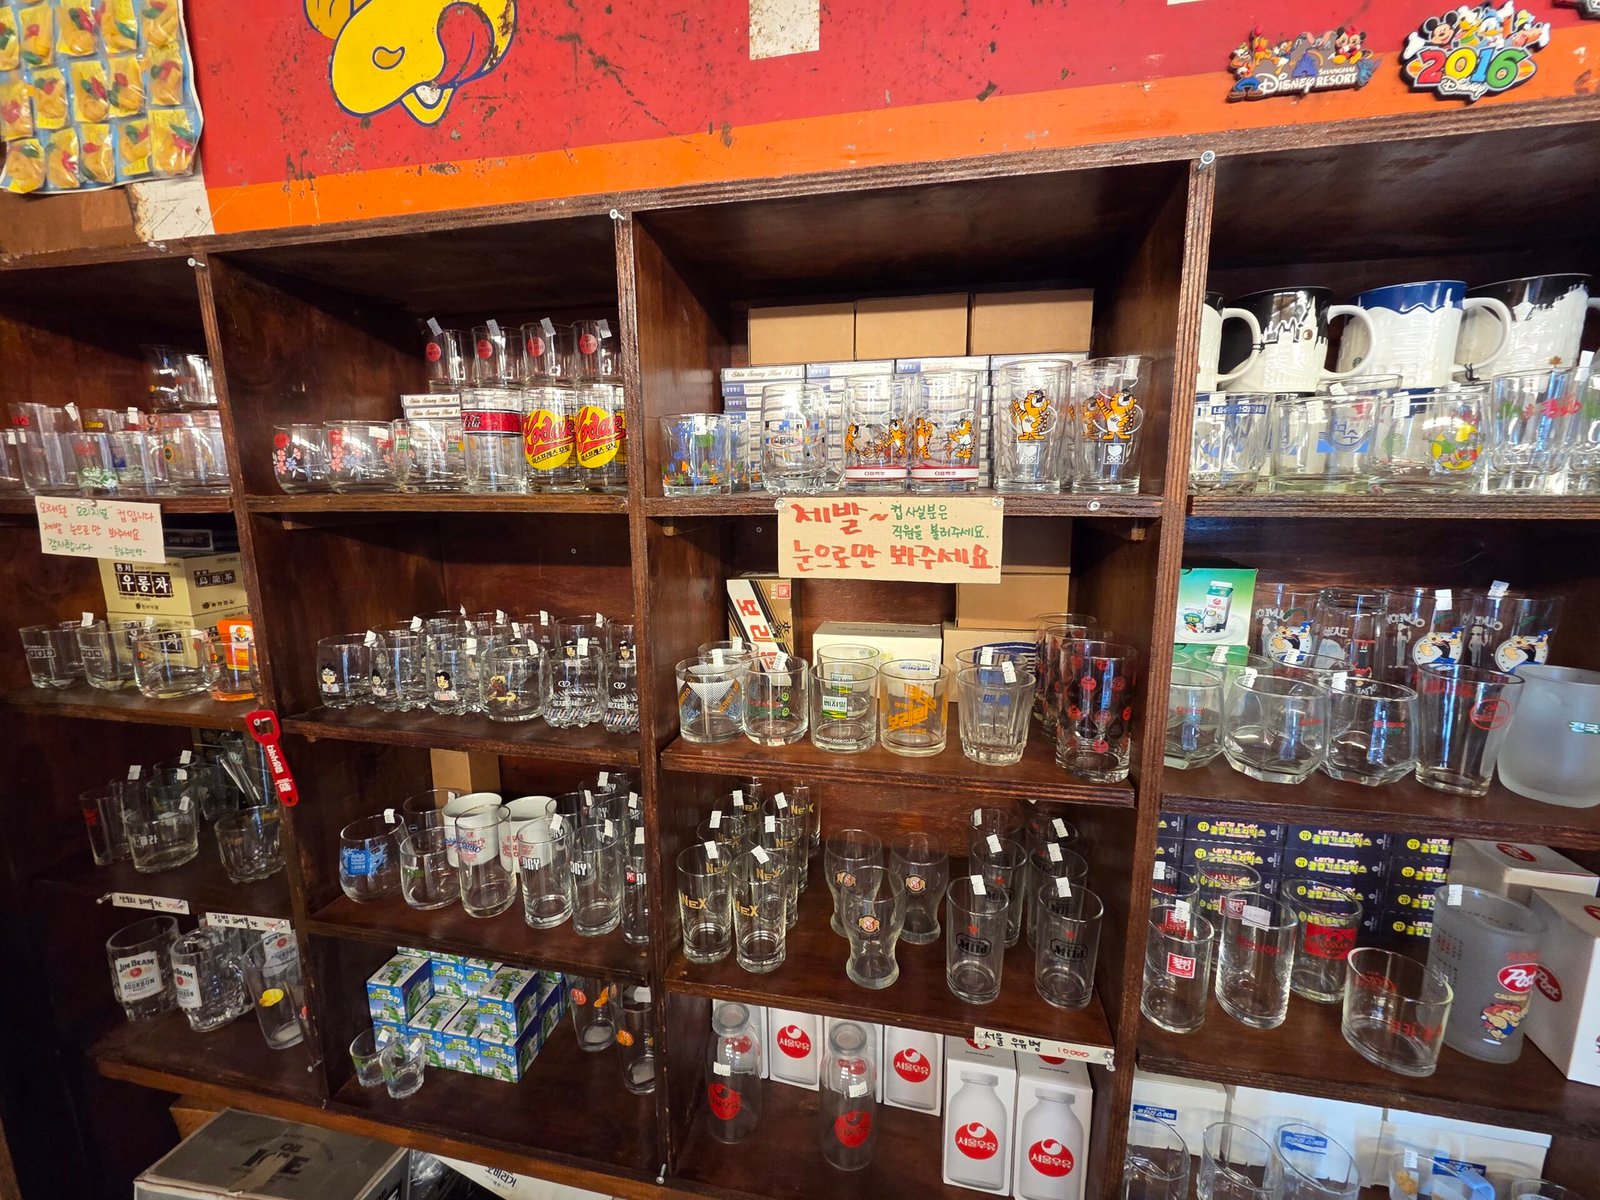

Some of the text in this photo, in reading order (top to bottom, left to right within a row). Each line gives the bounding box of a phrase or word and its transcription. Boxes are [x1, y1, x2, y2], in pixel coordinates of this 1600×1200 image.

[1318, 66, 1356, 76] SHANGHAI
[1417, 47, 1527, 89] 2016
[1316, 72, 1358, 87] RESORT
[890, 503, 948, 521] 컵 사실분은
[43, 522, 63, 535] 제발
[892, 524, 989, 541] 직원을 불러주세요.
[48, 538, 93, 551] 감사합니다
[792, 540, 882, 572] 눈으로만
[121, 574, 168, 594] 우롱차
[522, 856, 541, 871] DRY
[570, 860, 588, 876] DRY
[118, 958, 155, 973] JIM BEAM
[124, 978, 155, 991] BOURBON
[778, 1037, 812, 1052] 서울우유
[984, 1031, 1004, 1047] 서울
[895, 1061, 929, 1076] 서울우유
[957, 1135, 997, 1152] 서울우유
[1031, 1152, 1072, 1169] 서울우유
